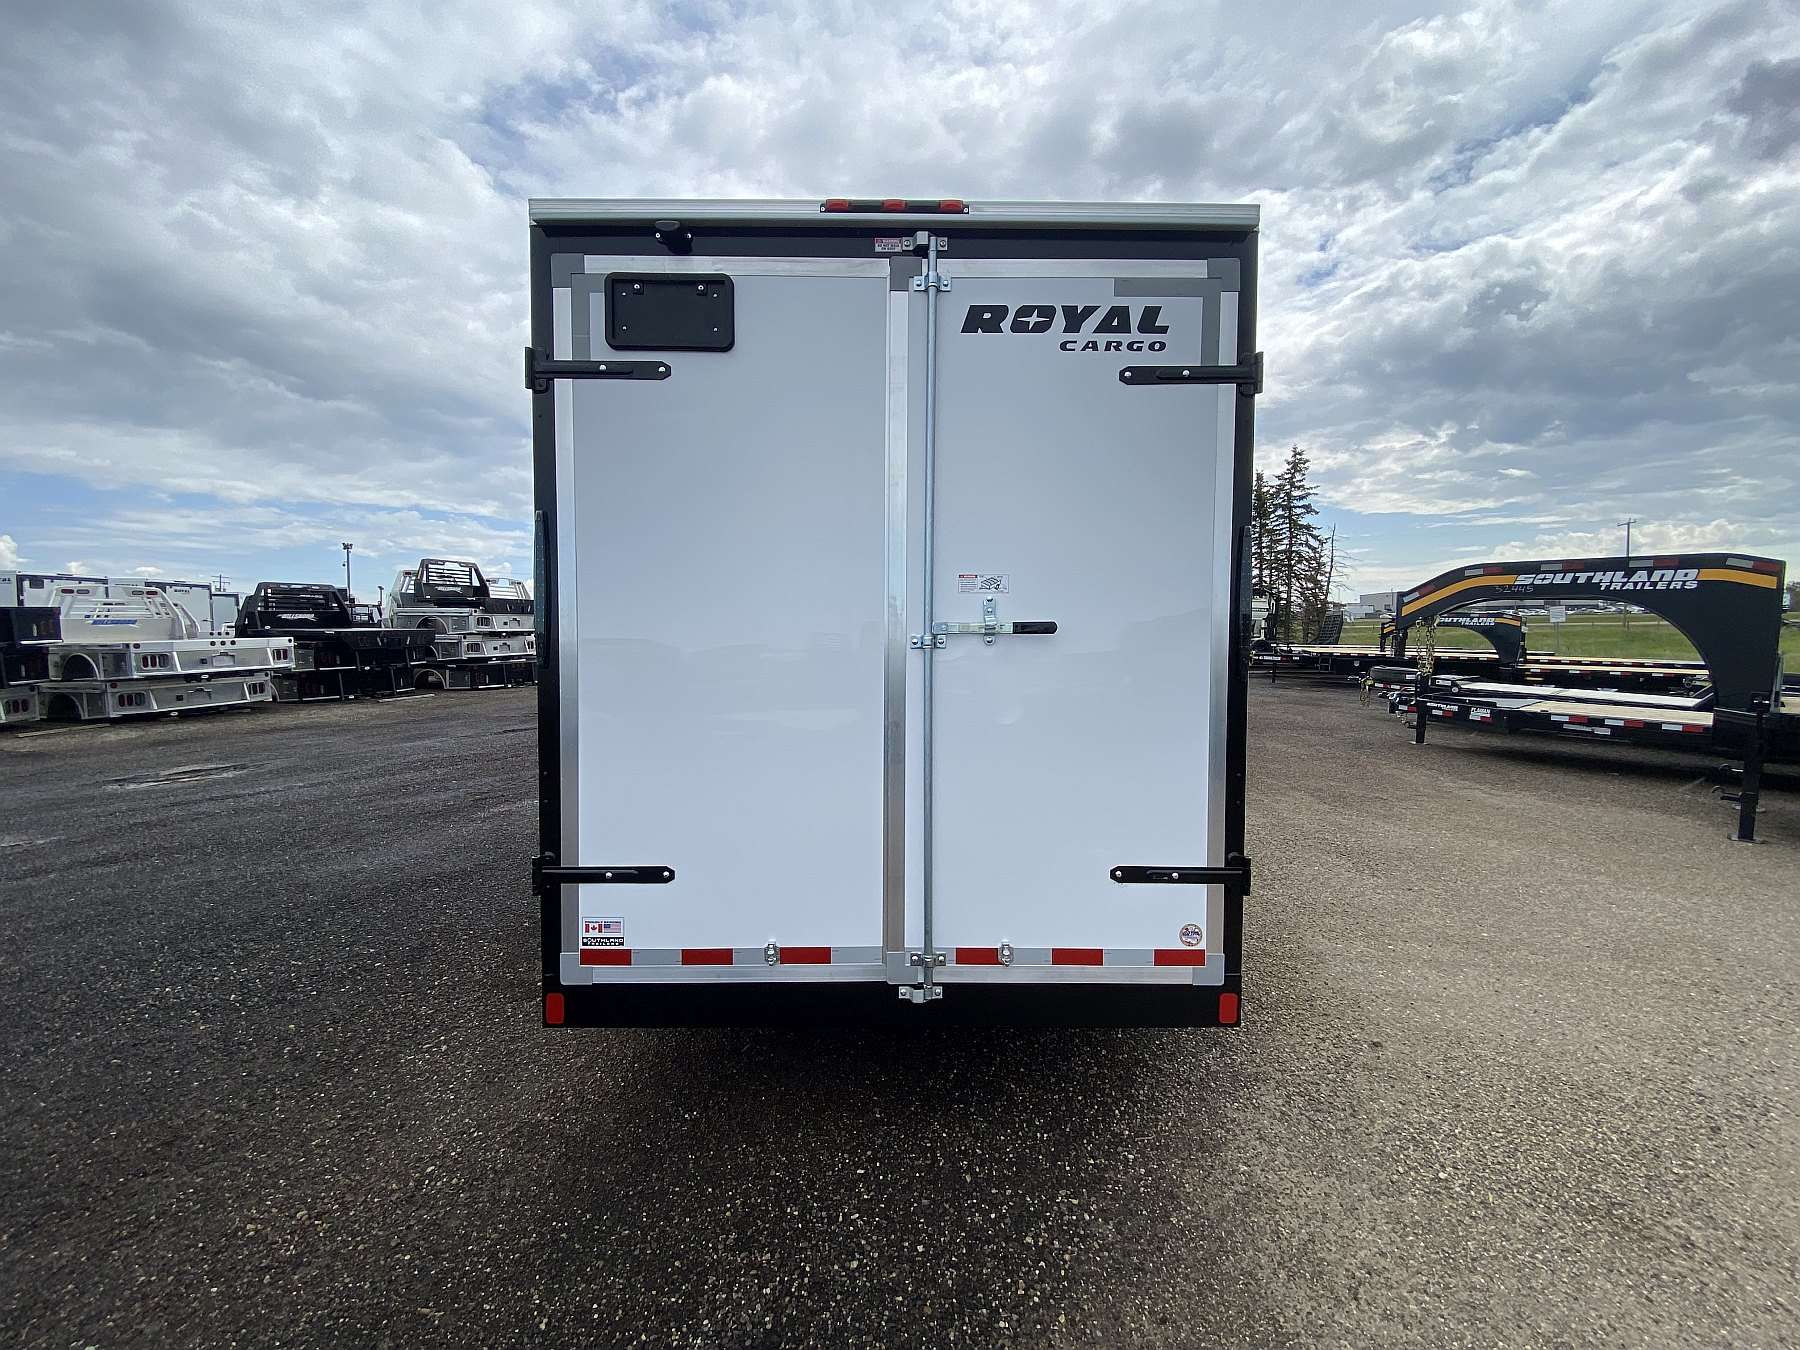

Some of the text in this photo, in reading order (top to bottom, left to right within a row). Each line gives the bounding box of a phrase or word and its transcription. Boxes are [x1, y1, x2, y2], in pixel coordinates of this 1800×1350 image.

[960, 304, 1169, 334] ROYAL
[1059, 340, 1167, 352] CARGO
[1514, 569, 1699, 585] SOUTHLAND
[1600, 581, 1698, 591] TRAILERS
